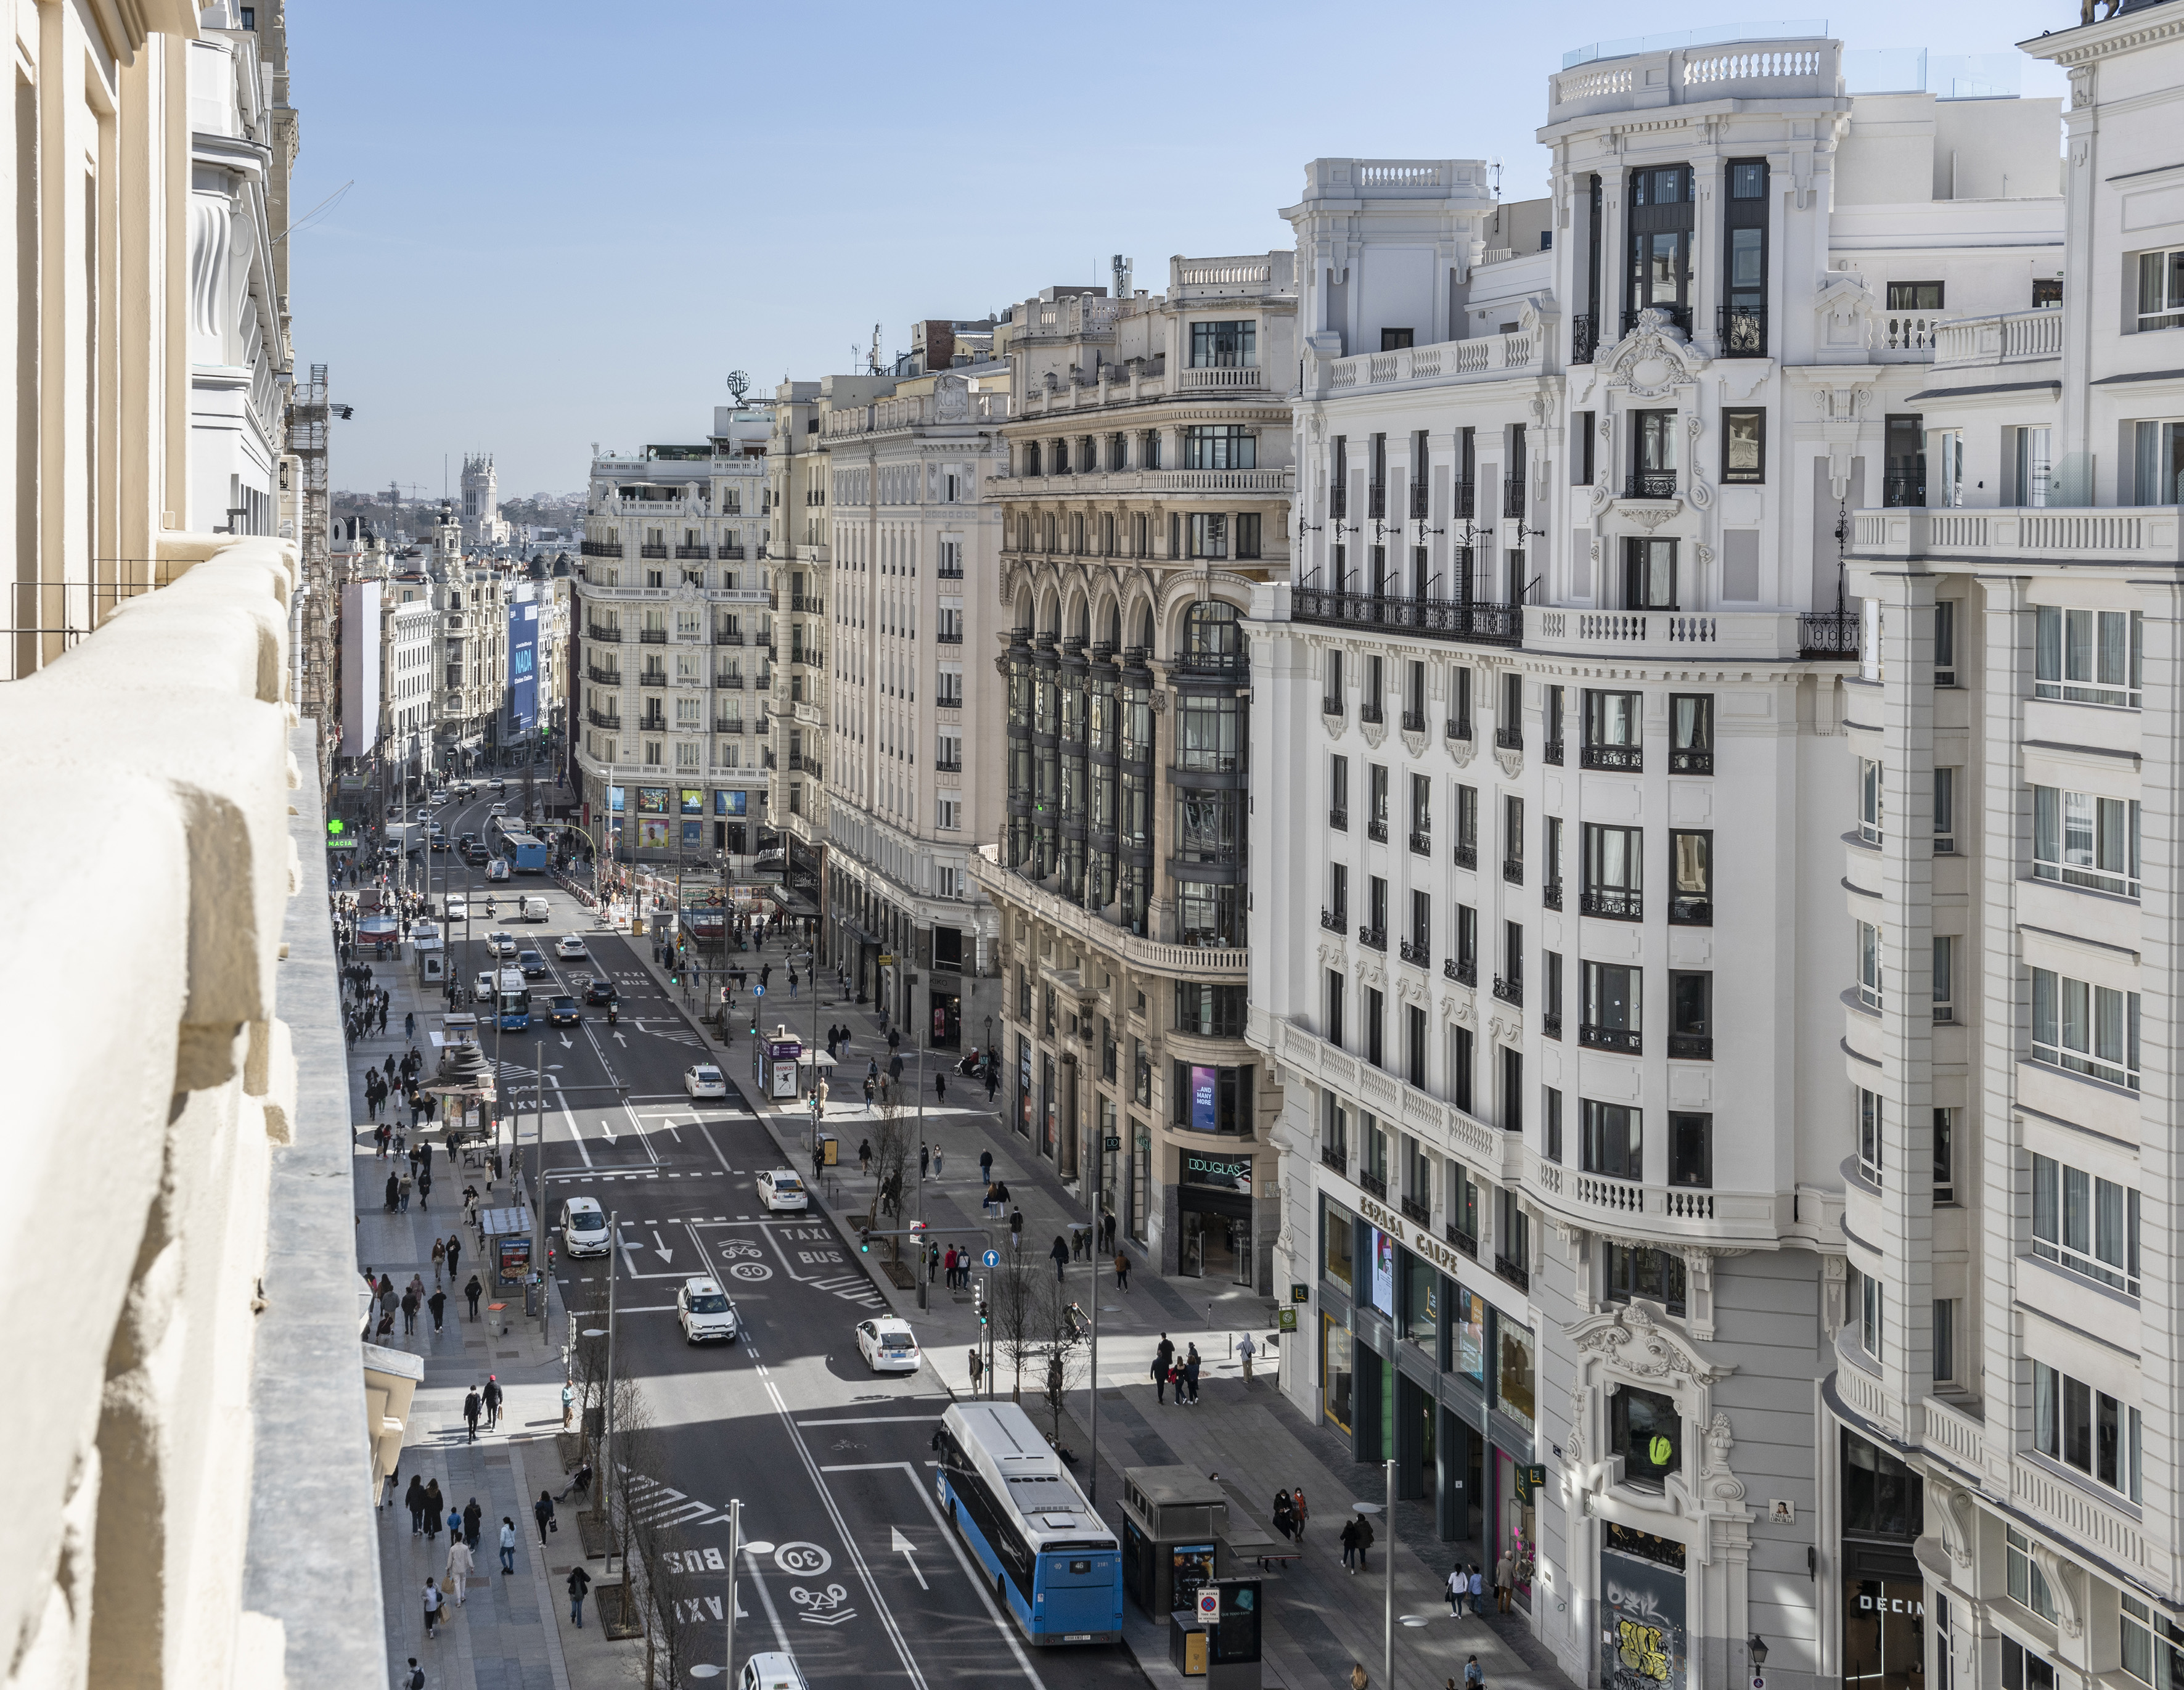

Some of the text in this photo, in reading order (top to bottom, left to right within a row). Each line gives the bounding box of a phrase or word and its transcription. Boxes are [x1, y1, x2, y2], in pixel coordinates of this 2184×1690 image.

[515, 649, 532, 675] NADA
[930, 978, 947, 987] KIKO
[509, 1099, 552, 1110] TAXI
[1188, 1158, 1241, 1176] DOUGLAS
[1360, 1196, 1405, 1240] ESPASA
[780, 1228, 832, 1240] TAXI
[798, 1251, 844, 1263] BUS
[1415, 1234, 1457, 1274] CALPE
[740, 1266, 763, 1276] 30
[663, 1548, 726, 1573] BUS
[787, 1550, 819, 1568] 30
